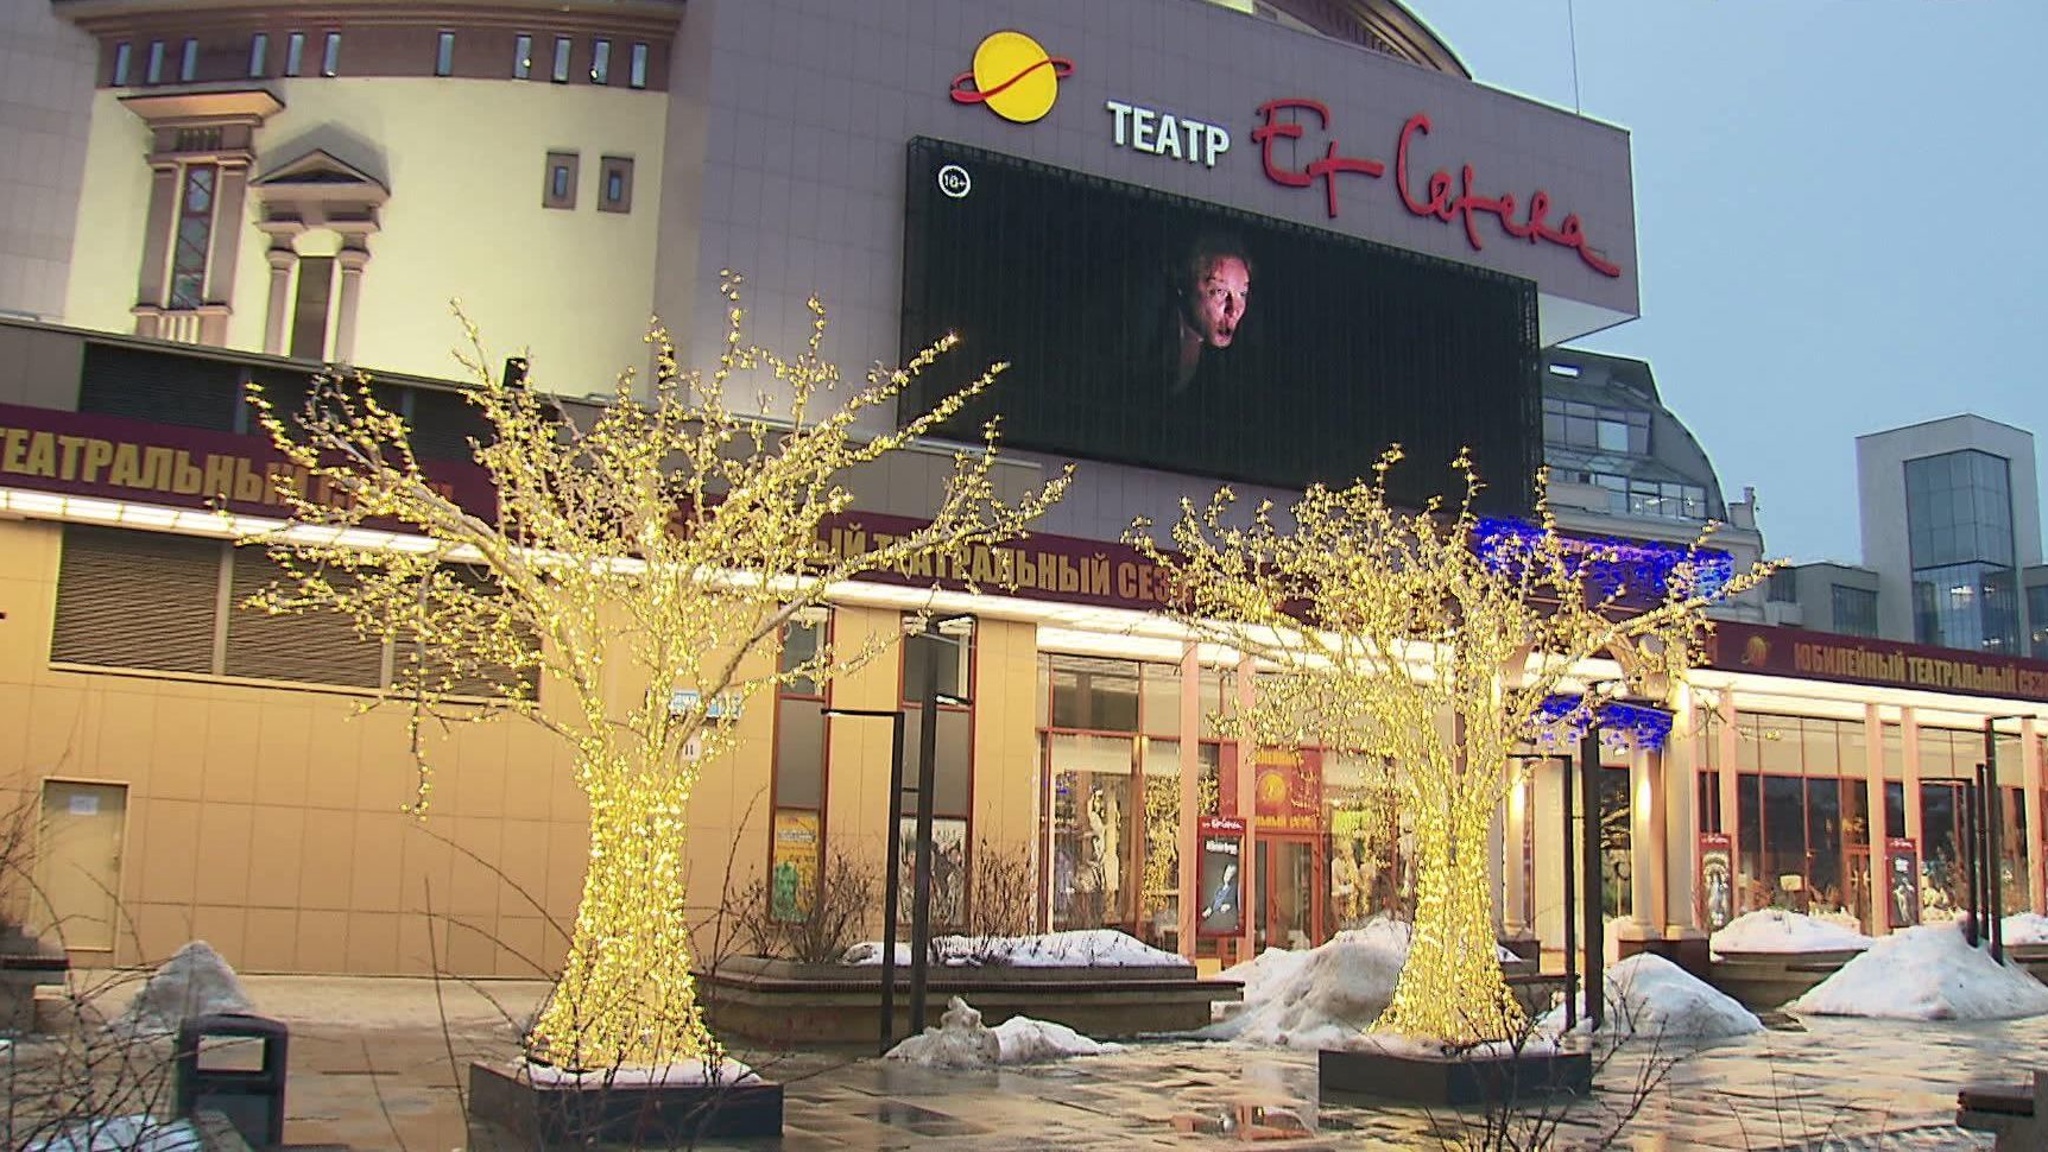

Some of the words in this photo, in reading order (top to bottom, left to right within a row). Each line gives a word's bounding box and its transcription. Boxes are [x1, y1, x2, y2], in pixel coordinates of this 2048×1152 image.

[1106, 100, 1231, 167] ТЕАТР
[0, 426, 309, 509] ЕАТРАЛЬНЫ
[1793, 642, 1907, 683] ЮБИЛЕЙНЫЙ
[1908, 656, 2018, 695] ТЕАТРАЛЬНЫЙ
